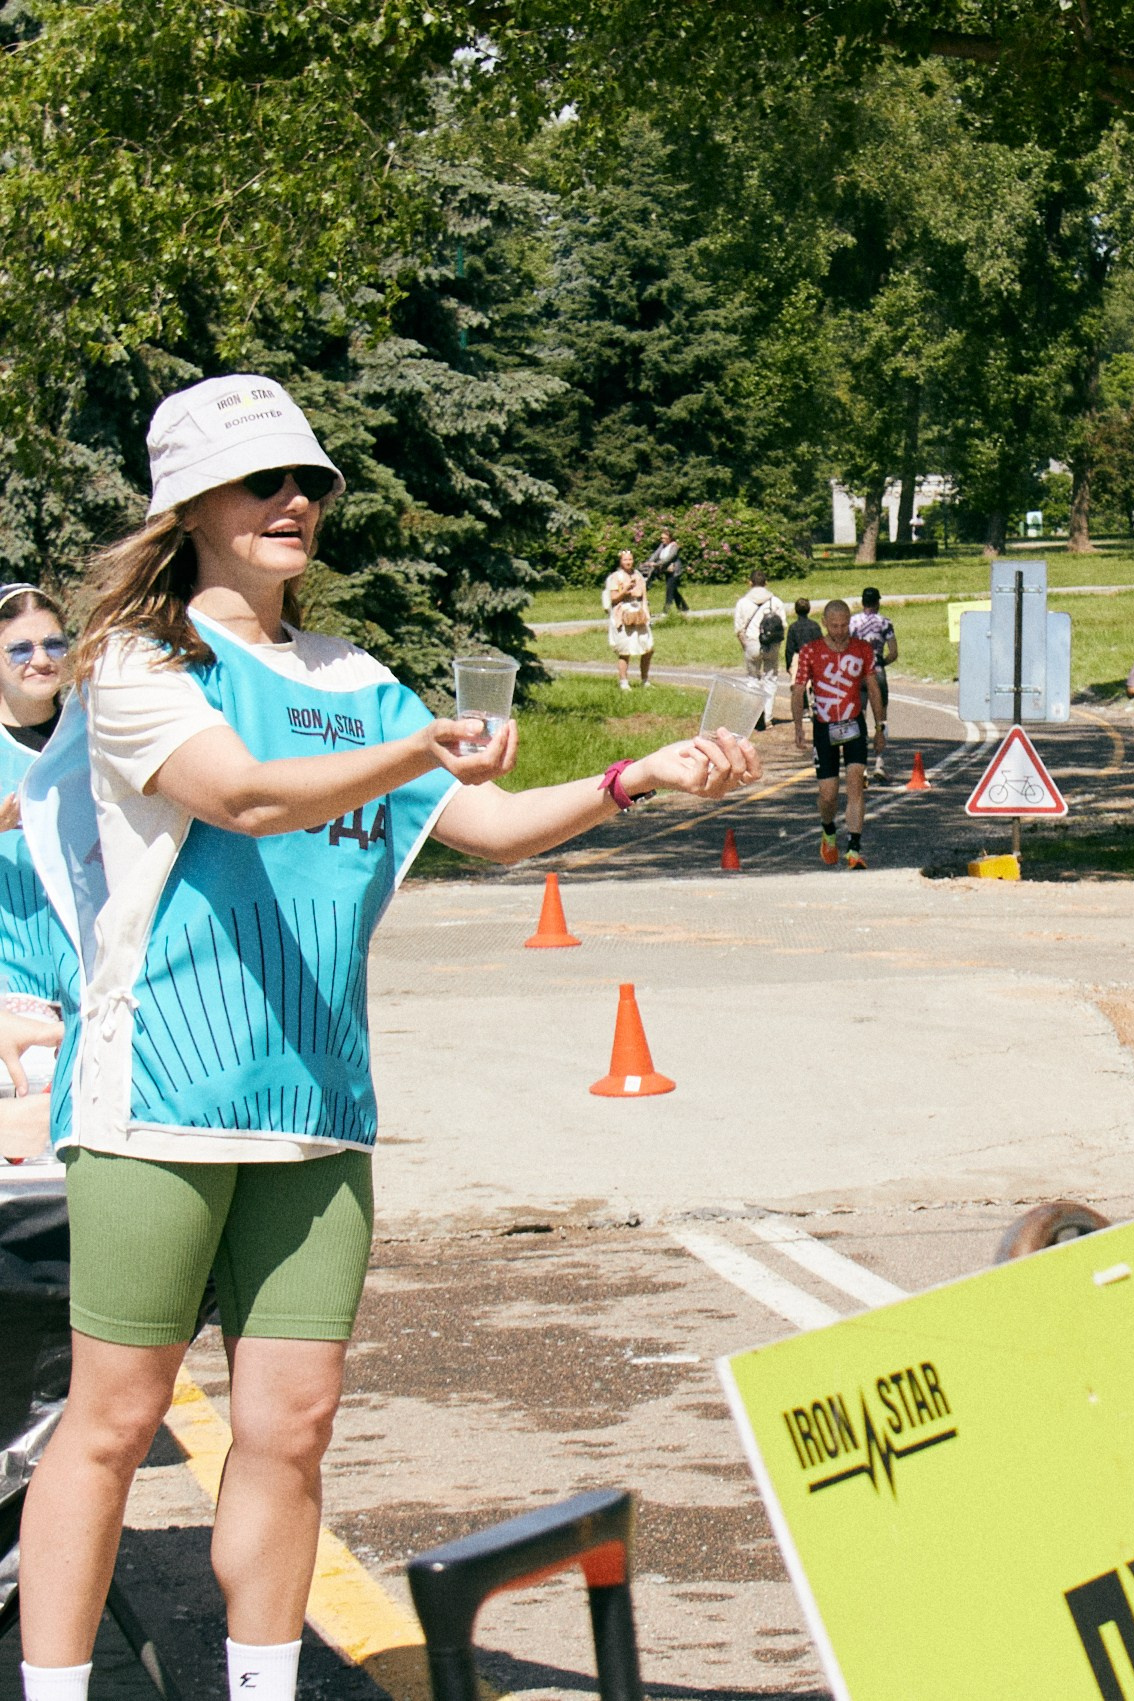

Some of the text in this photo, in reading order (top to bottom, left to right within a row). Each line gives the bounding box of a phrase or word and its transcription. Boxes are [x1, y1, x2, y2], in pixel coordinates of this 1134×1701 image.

[217, 389, 275, 410] IRON STAR
[815, 654, 864, 722] Alfa
[286, 706, 366, 738] IRON STAR
[783, 1360, 951, 1469] IRON STAR
